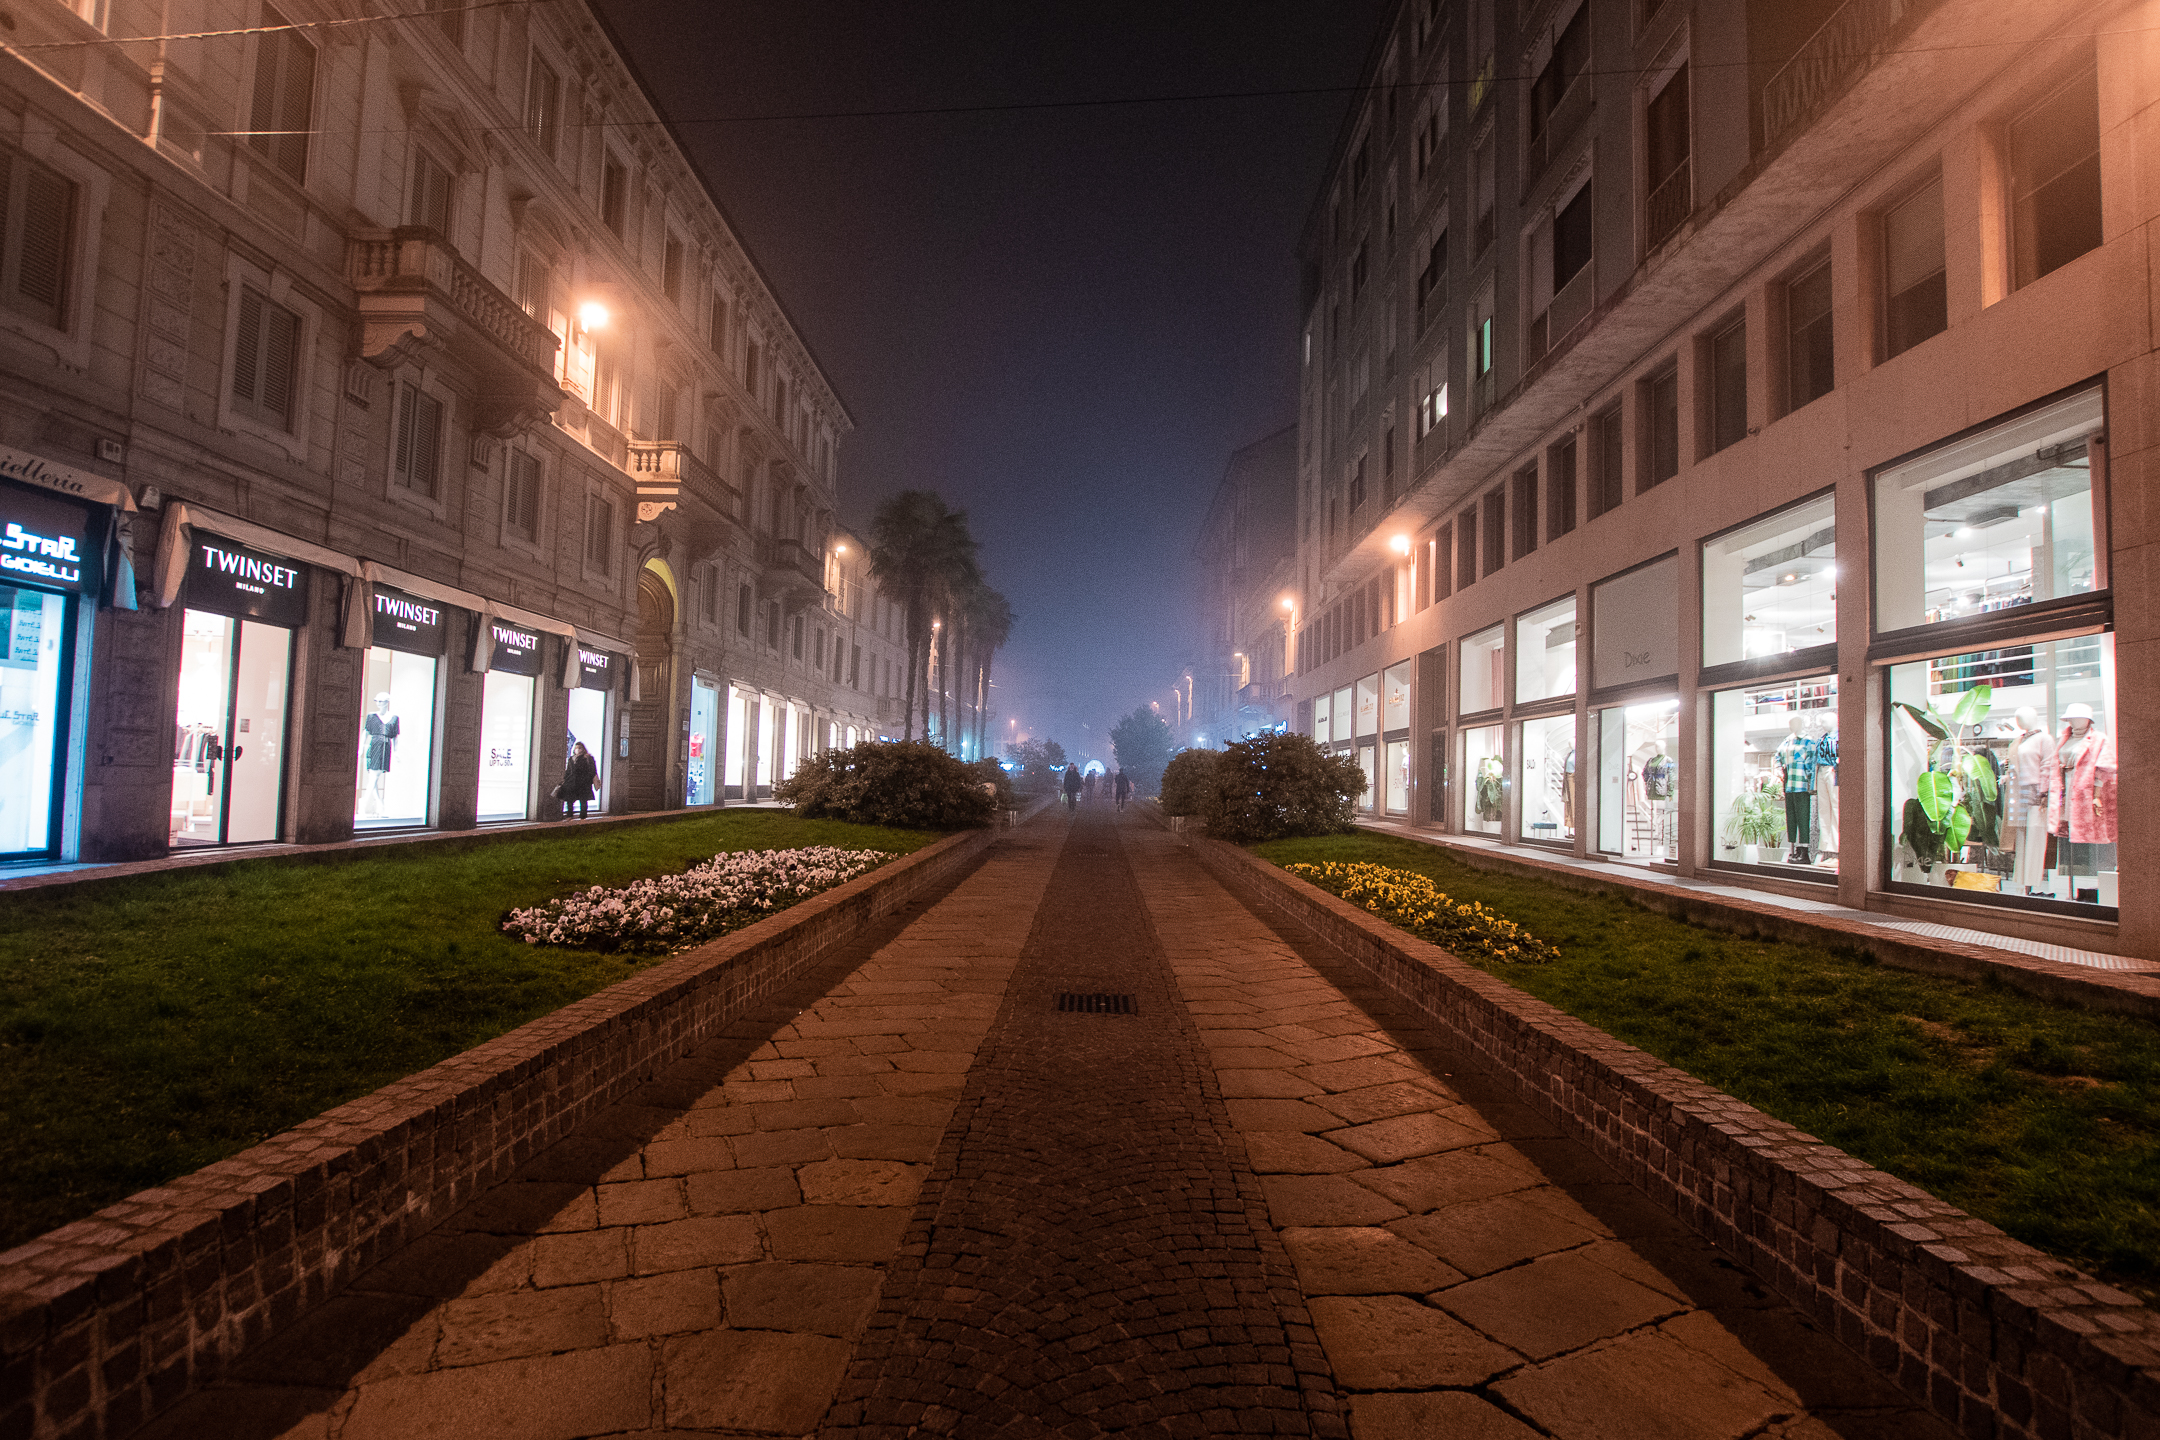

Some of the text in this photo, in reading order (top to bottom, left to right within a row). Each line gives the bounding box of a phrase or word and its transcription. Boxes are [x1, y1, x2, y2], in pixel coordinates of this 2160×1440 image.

[0, 554, 80, 582] GIOIELLI
[202, 545, 298, 589] TWINSET
[235, 582, 265, 595] MILANO
[375, 594, 439, 626] TWINSET
[1624, 651, 1651, 668] Dixie
